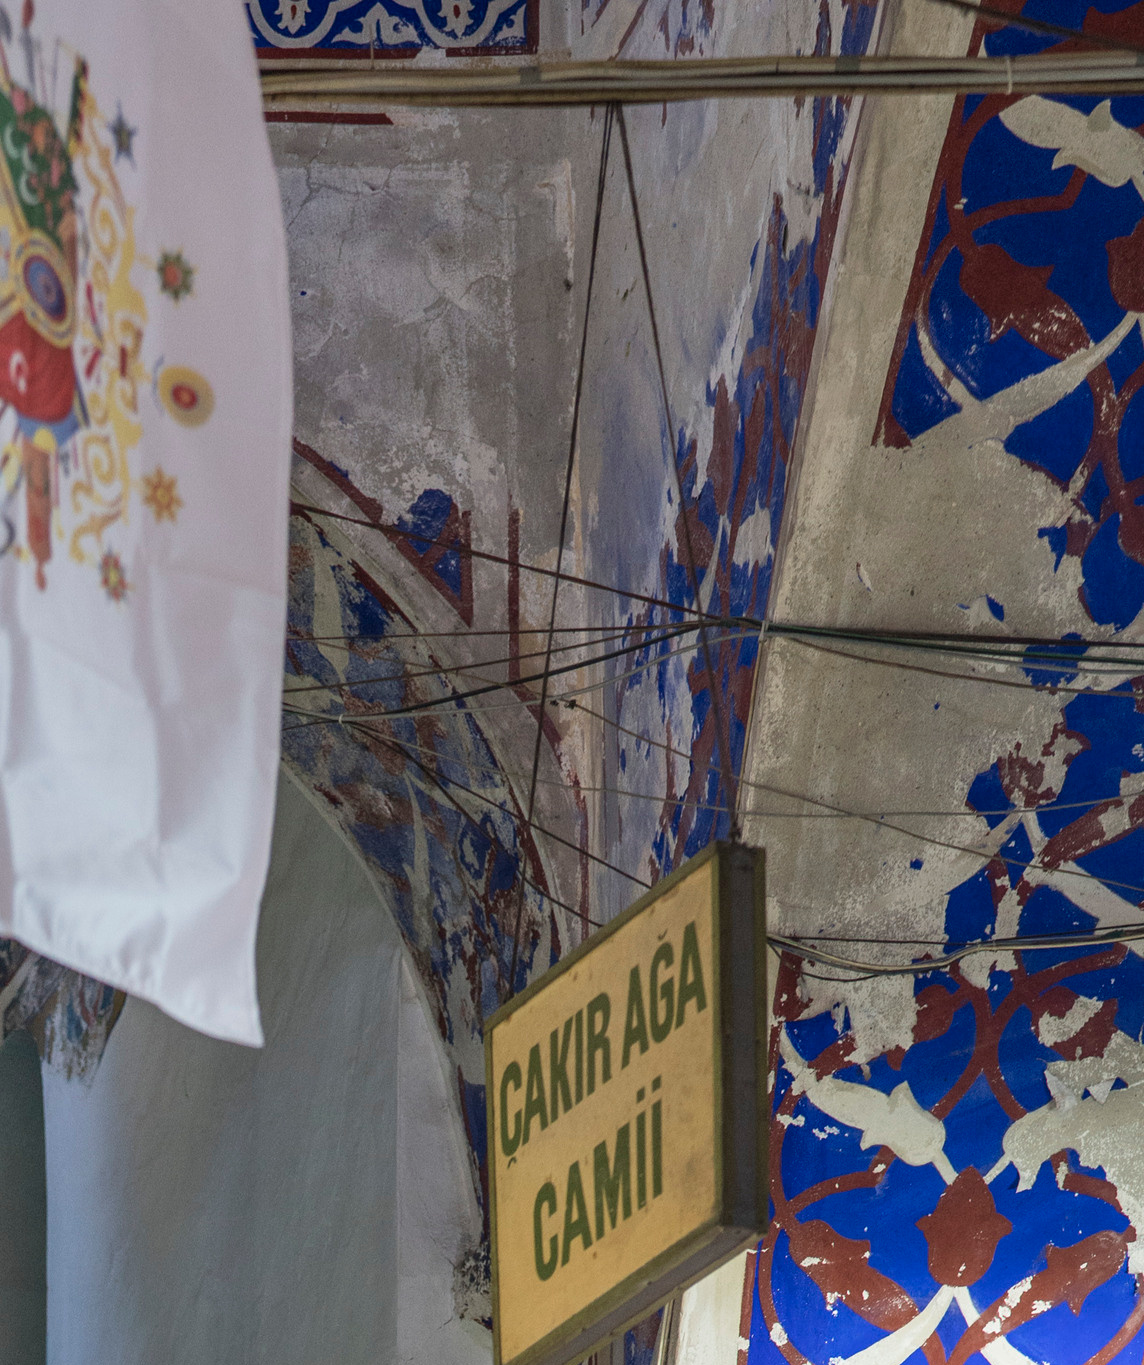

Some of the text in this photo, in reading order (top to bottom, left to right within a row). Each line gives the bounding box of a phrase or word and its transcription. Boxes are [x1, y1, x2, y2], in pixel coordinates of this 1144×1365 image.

[499, 920, 708, 1169] ÇAKIR AĞA
[533, 1075, 664, 1283] CAMİİ
